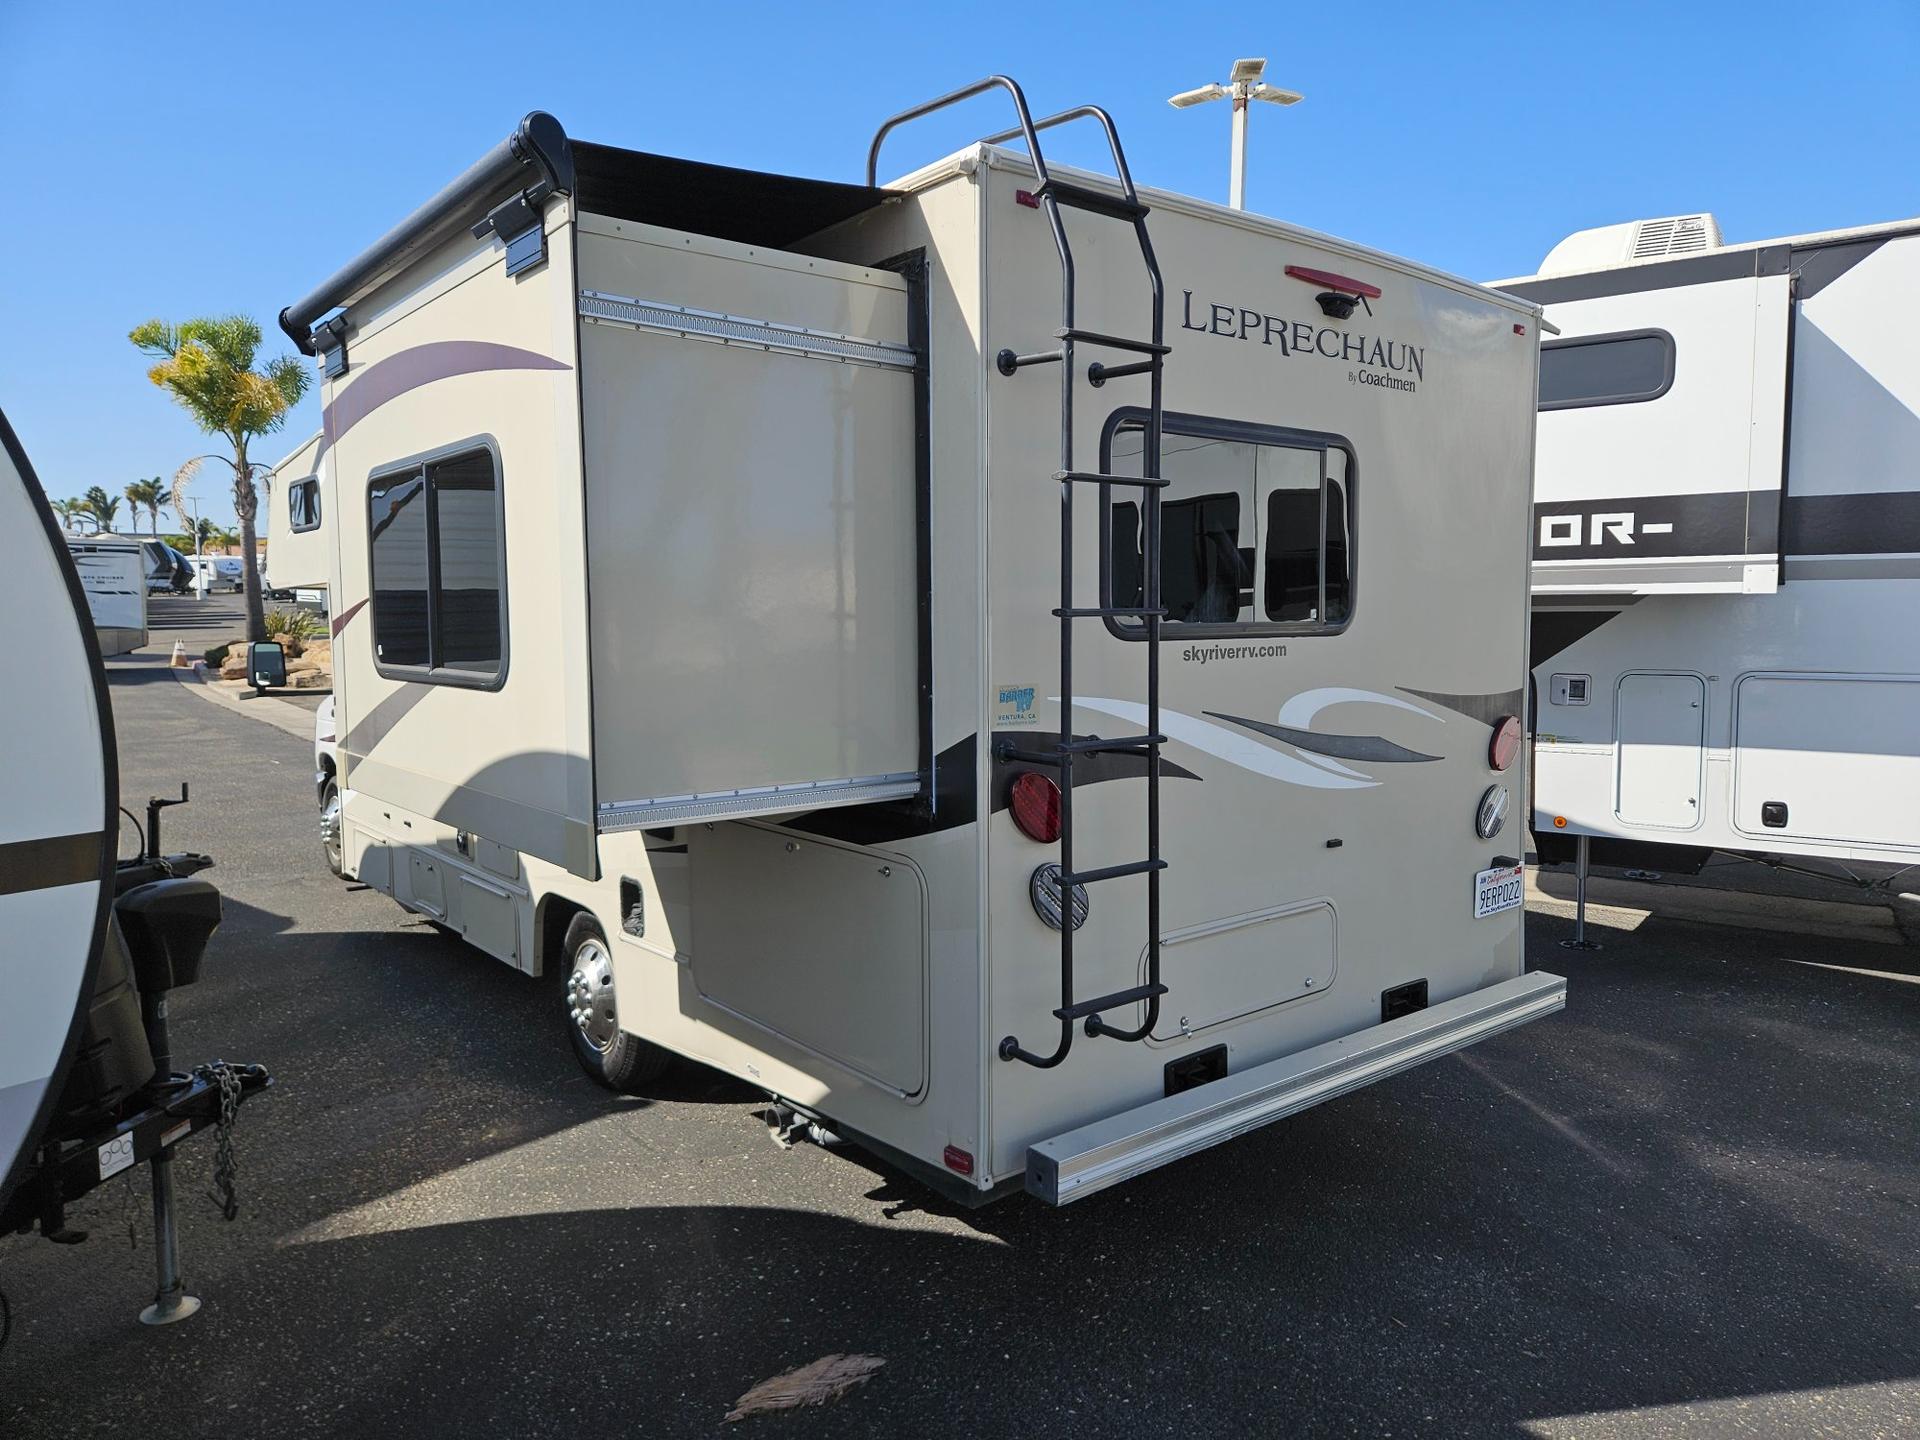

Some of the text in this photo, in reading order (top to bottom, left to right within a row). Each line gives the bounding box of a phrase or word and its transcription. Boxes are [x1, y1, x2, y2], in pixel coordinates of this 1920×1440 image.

[1181, 288, 1424, 382] LEPRECHAUN
[1348, 369, 1416, 393] By Coachmen
[1183, 644, 1287, 664] skyriverrv.com
[1480, 880, 1520, 909] 9ERP022
